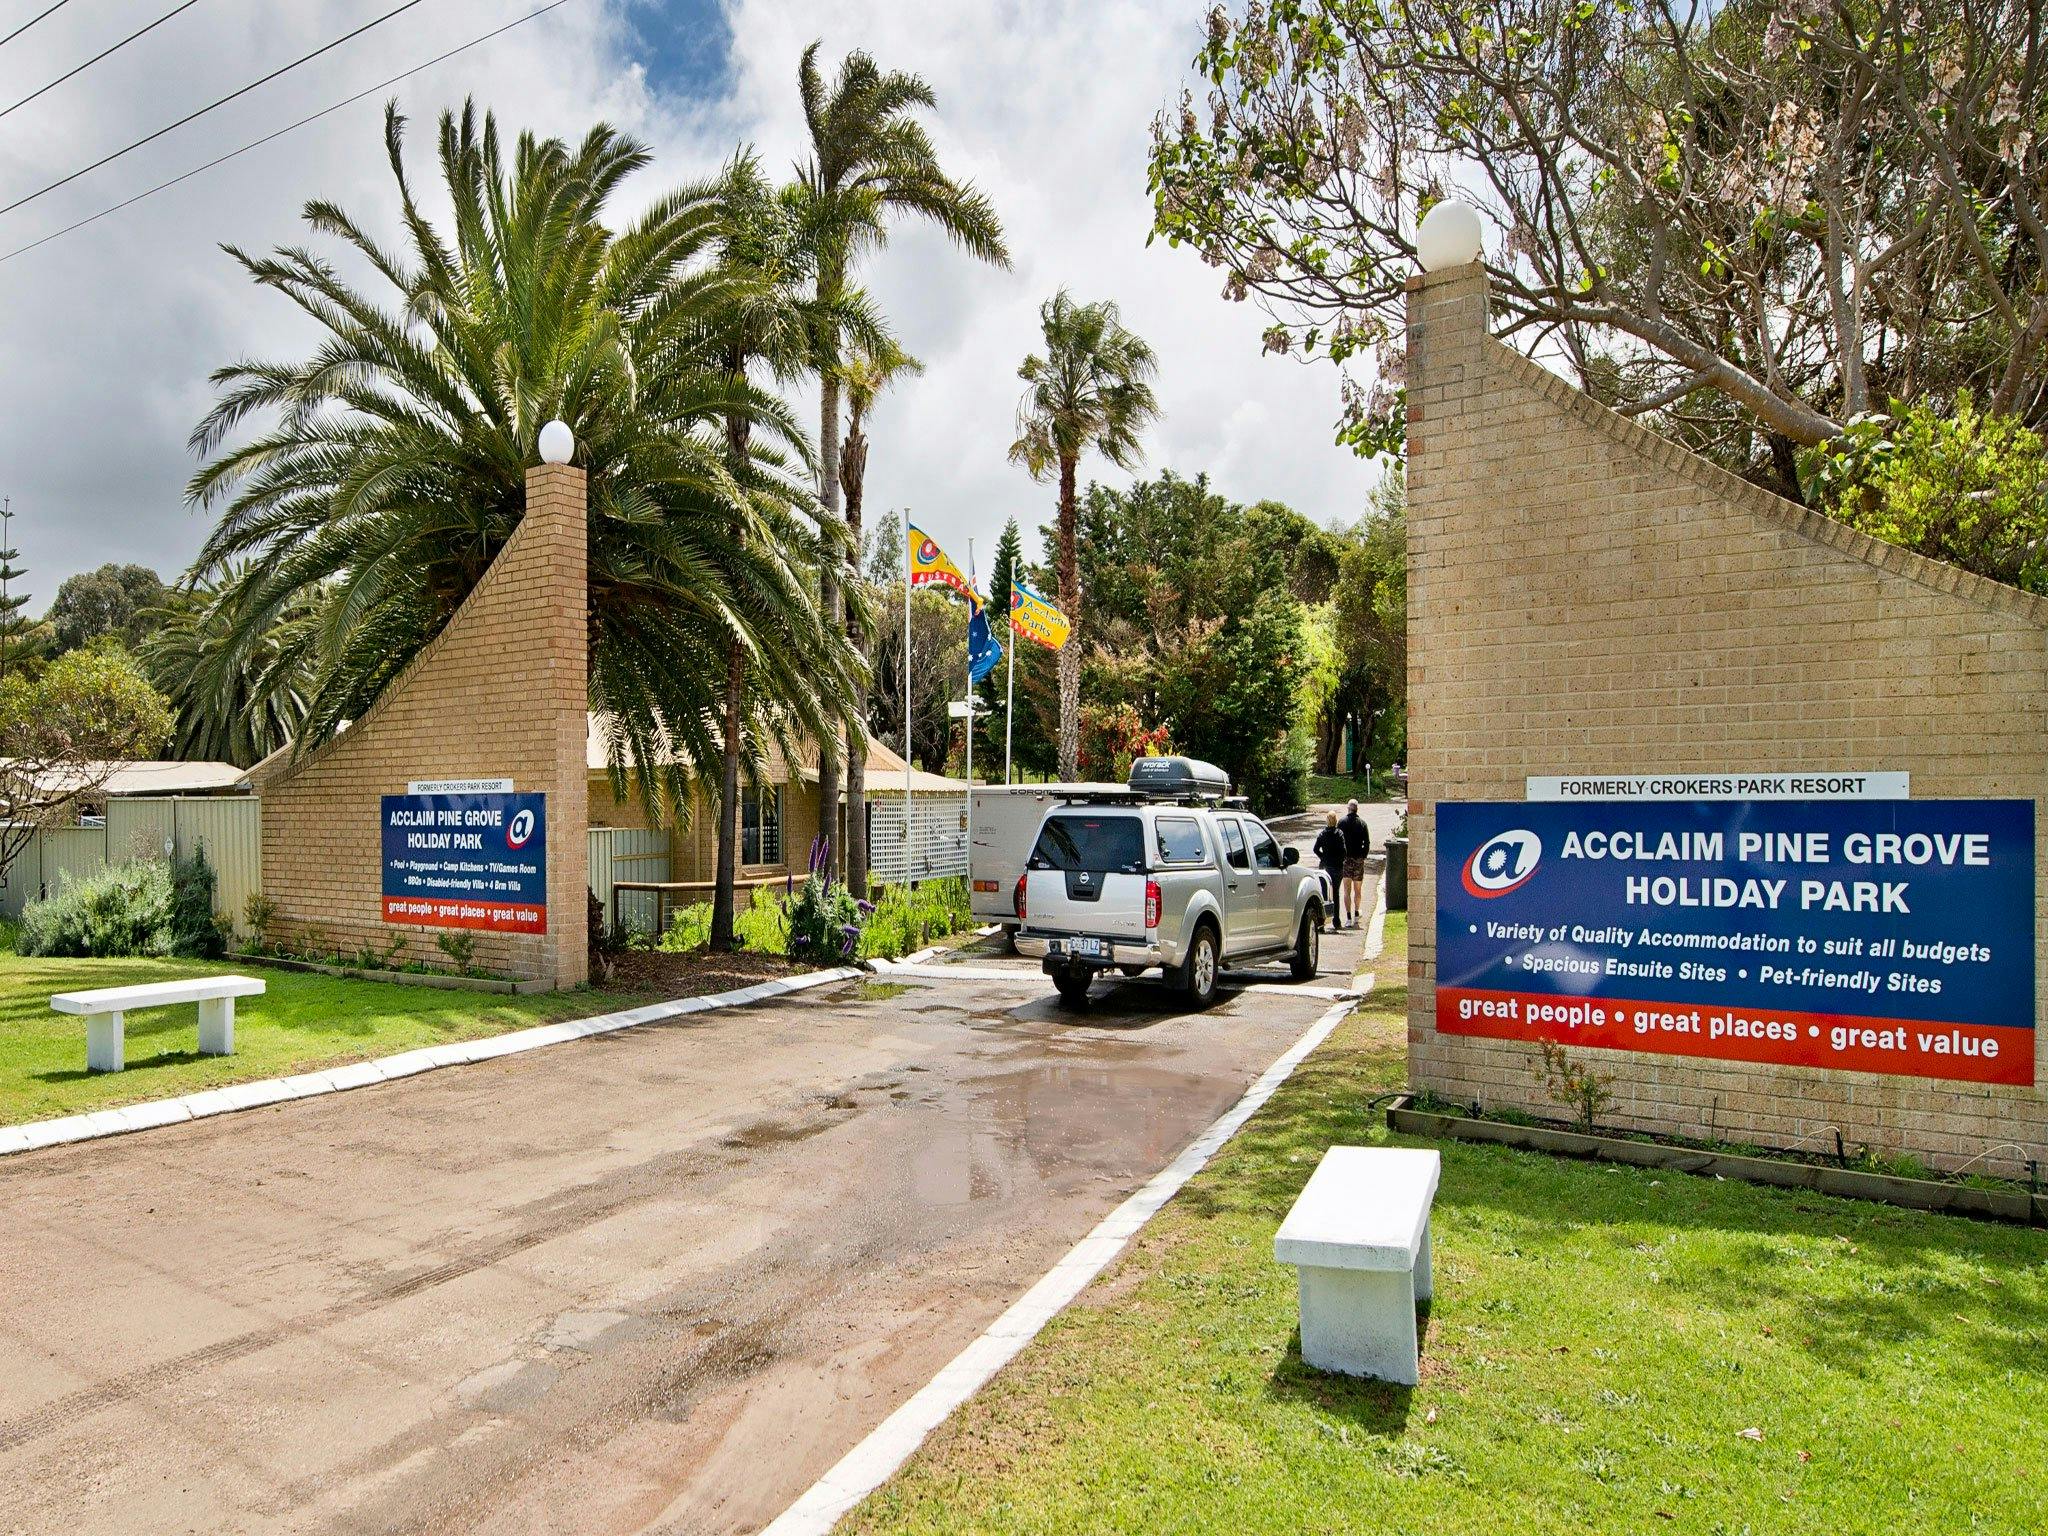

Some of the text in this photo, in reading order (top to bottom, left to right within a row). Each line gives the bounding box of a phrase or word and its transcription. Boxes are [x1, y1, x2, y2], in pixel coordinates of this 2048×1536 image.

[919, 571, 965, 592] AUSTRA
[1022, 612, 1051, 637] Parks
[417, 781, 502, 792] FORMERLY CROKERS PARK RESORT
[1560, 778, 1866, 795] FORMERLY CROKERS PARK RESORT
[390, 810, 502, 827] ACCLAIM PINE GROVE
[407, 832, 483, 850] HOLIDAY PARK
[1560, 831, 1990, 866] ACCLAIM PINE GROVE
[393, 860, 537, 874] Pool Playground Camp Kitchens TV/Games Room
[407, 875, 521, 892] BBQs Disabled-friendly Villa 4 Brm Villa
[1626, 876, 1911, 914] HOLIDAY PARK
[388, 901, 539, 922] great people great places great value
[1486, 921, 1992, 964] Variety of Quality Accommodation to suit all budgets
[1522, 953, 1942, 994] Spacious Ensuite Sites Pet-friendly Sites
[1459, 998, 1999, 1058] great people great places great value
